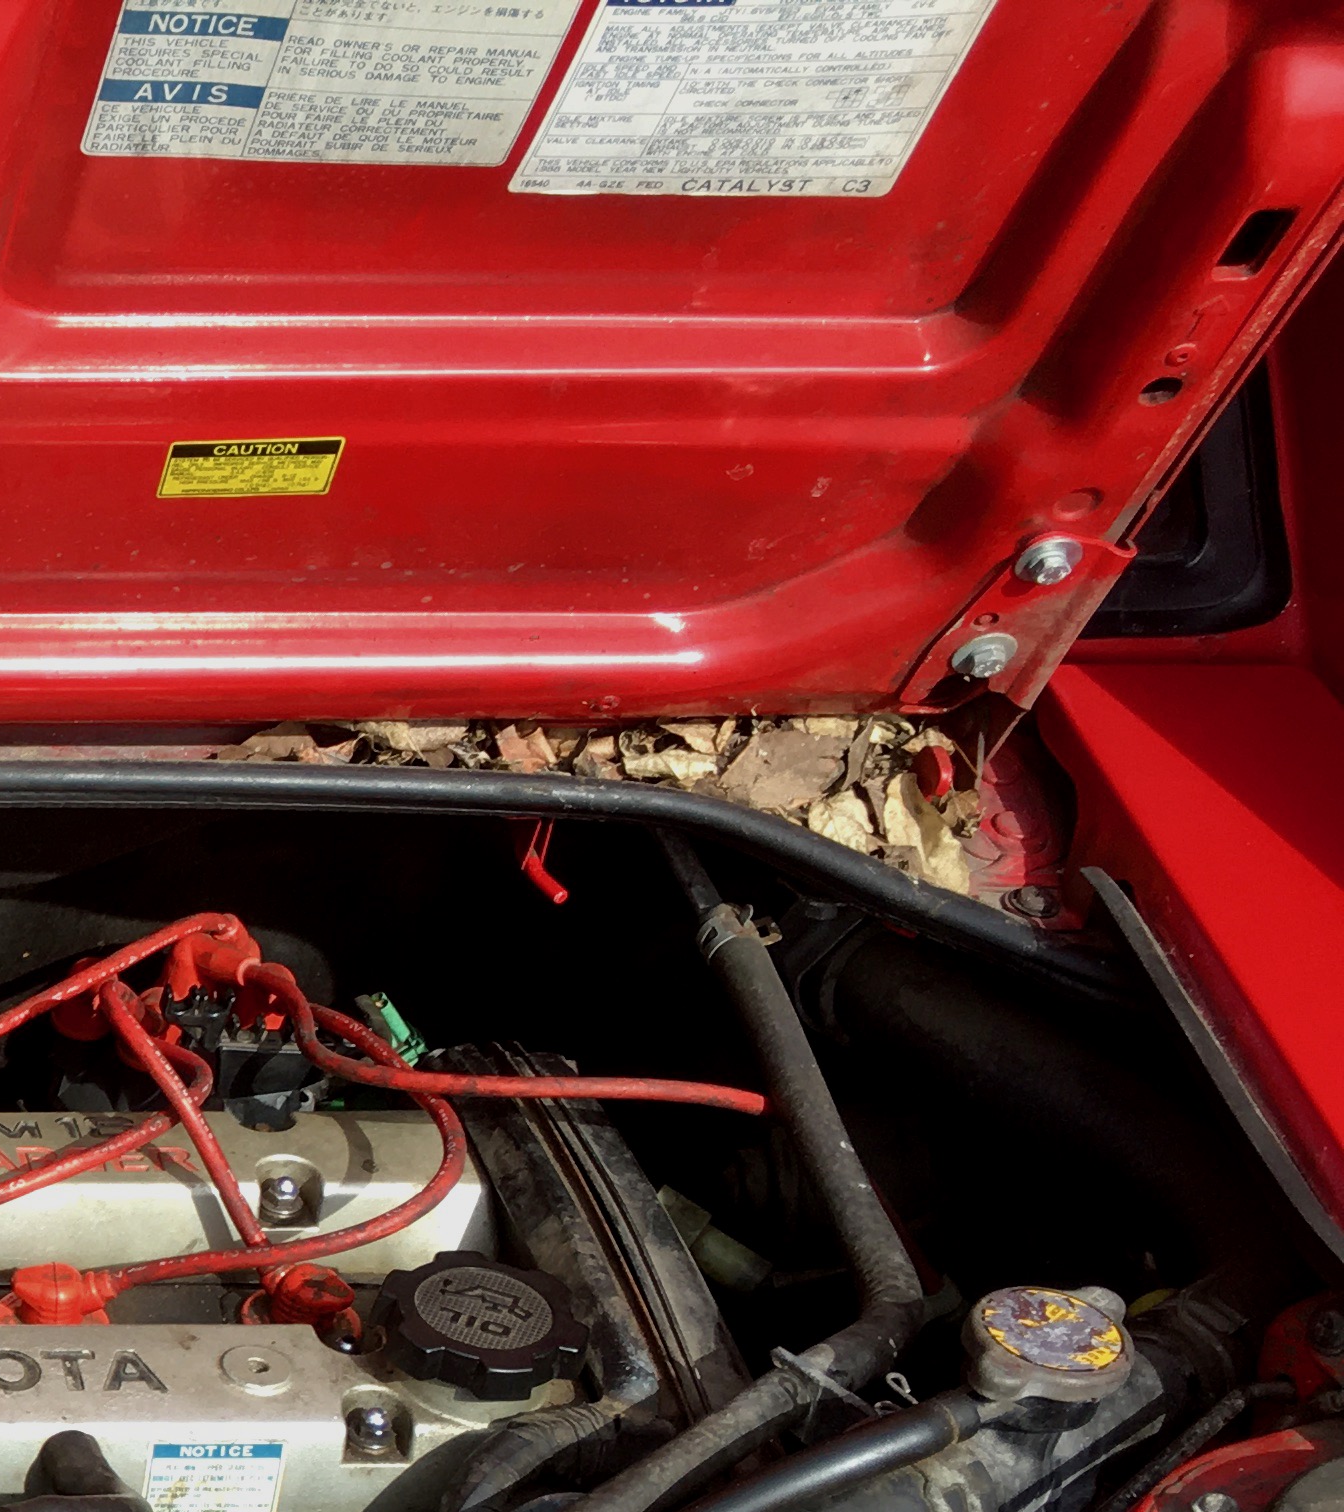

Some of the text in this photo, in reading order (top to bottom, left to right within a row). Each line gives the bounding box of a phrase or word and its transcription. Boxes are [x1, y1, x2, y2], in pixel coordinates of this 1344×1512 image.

[612, 8, 652, 16] ENGINE
[148, 14, 259, 37] NOTICE
[123, 36, 229, 48] THIS VEHICLE
[288, 35, 541, 60] READ OWNER'S OR REPAIR MANUAL
[118, 47, 263, 63] REQUIRES SPECIAL
[284, 45, 313, 57] FOR
[320, 48, 372, 61] FILLING
[382, 51, 450, 65] COOLANT
[798, 52, 821, 61] FOR
[827, 51, 847, 60] ALL
[115, 57, 251, 72] COOLANT FILLING
[280, 55, 534, 79] FAILURE TO DO SO COULD RESULT
[112, 67, 201, 79] PROCEDURE
[277, 65, 292, 76] IN
[299, 67, 356, 80] SERIOUS
[365, 71, 420, 84] DAMAGE
[431, 74, 448, 84] TO
[574, 80, 620, 88] IGNITION
[763, 79, 799, 88] CHECK
[134, 83, 229, 103] AVIS
[101, 103, 120, 114] CE
[264, 101, 402, 118] DE SERVICE OU DU
[324, 95, 469, 112] DE LIRE LE MANUEL
[693, 99, 800, 108] CHECK CONNECTOR
[98, 113, 141, 124] EXIGE
[150, 114, 171, 124] UN
[261, 110, 444, 128] POUR FAIRE LE PLEIN DU
[95, 122, 239, 137] PARTICULIER POUR
[257, 119, 332, 133] RADIATEUR
[92, 132, 242, 147] FAIRE LE PLEIN DU
[250, 138, 317, 150] POURRAIT
[370, 143, 390, 152] DE
[332, 132, 351, 142] DE
[396, 135, 415, 145] LE
[422, 136, 477, 148] MOTEUR
[585, 137, 650, 146] CLEARANCE
[538, 158, 561, 166] THIS
[566, 159, 609, 167] VEHICLE
[610, 166, 638, 174] YEAR
[635, 181, 664, 189] FED
[681, 178, 813, 193] CATALYST
[841, 179, 872, 193] C3
[213, 443, 299, 456] CAUTION
[439, 1306, 512, 1338] OIL
[179, 1445, 254, 1458] NOTICE
